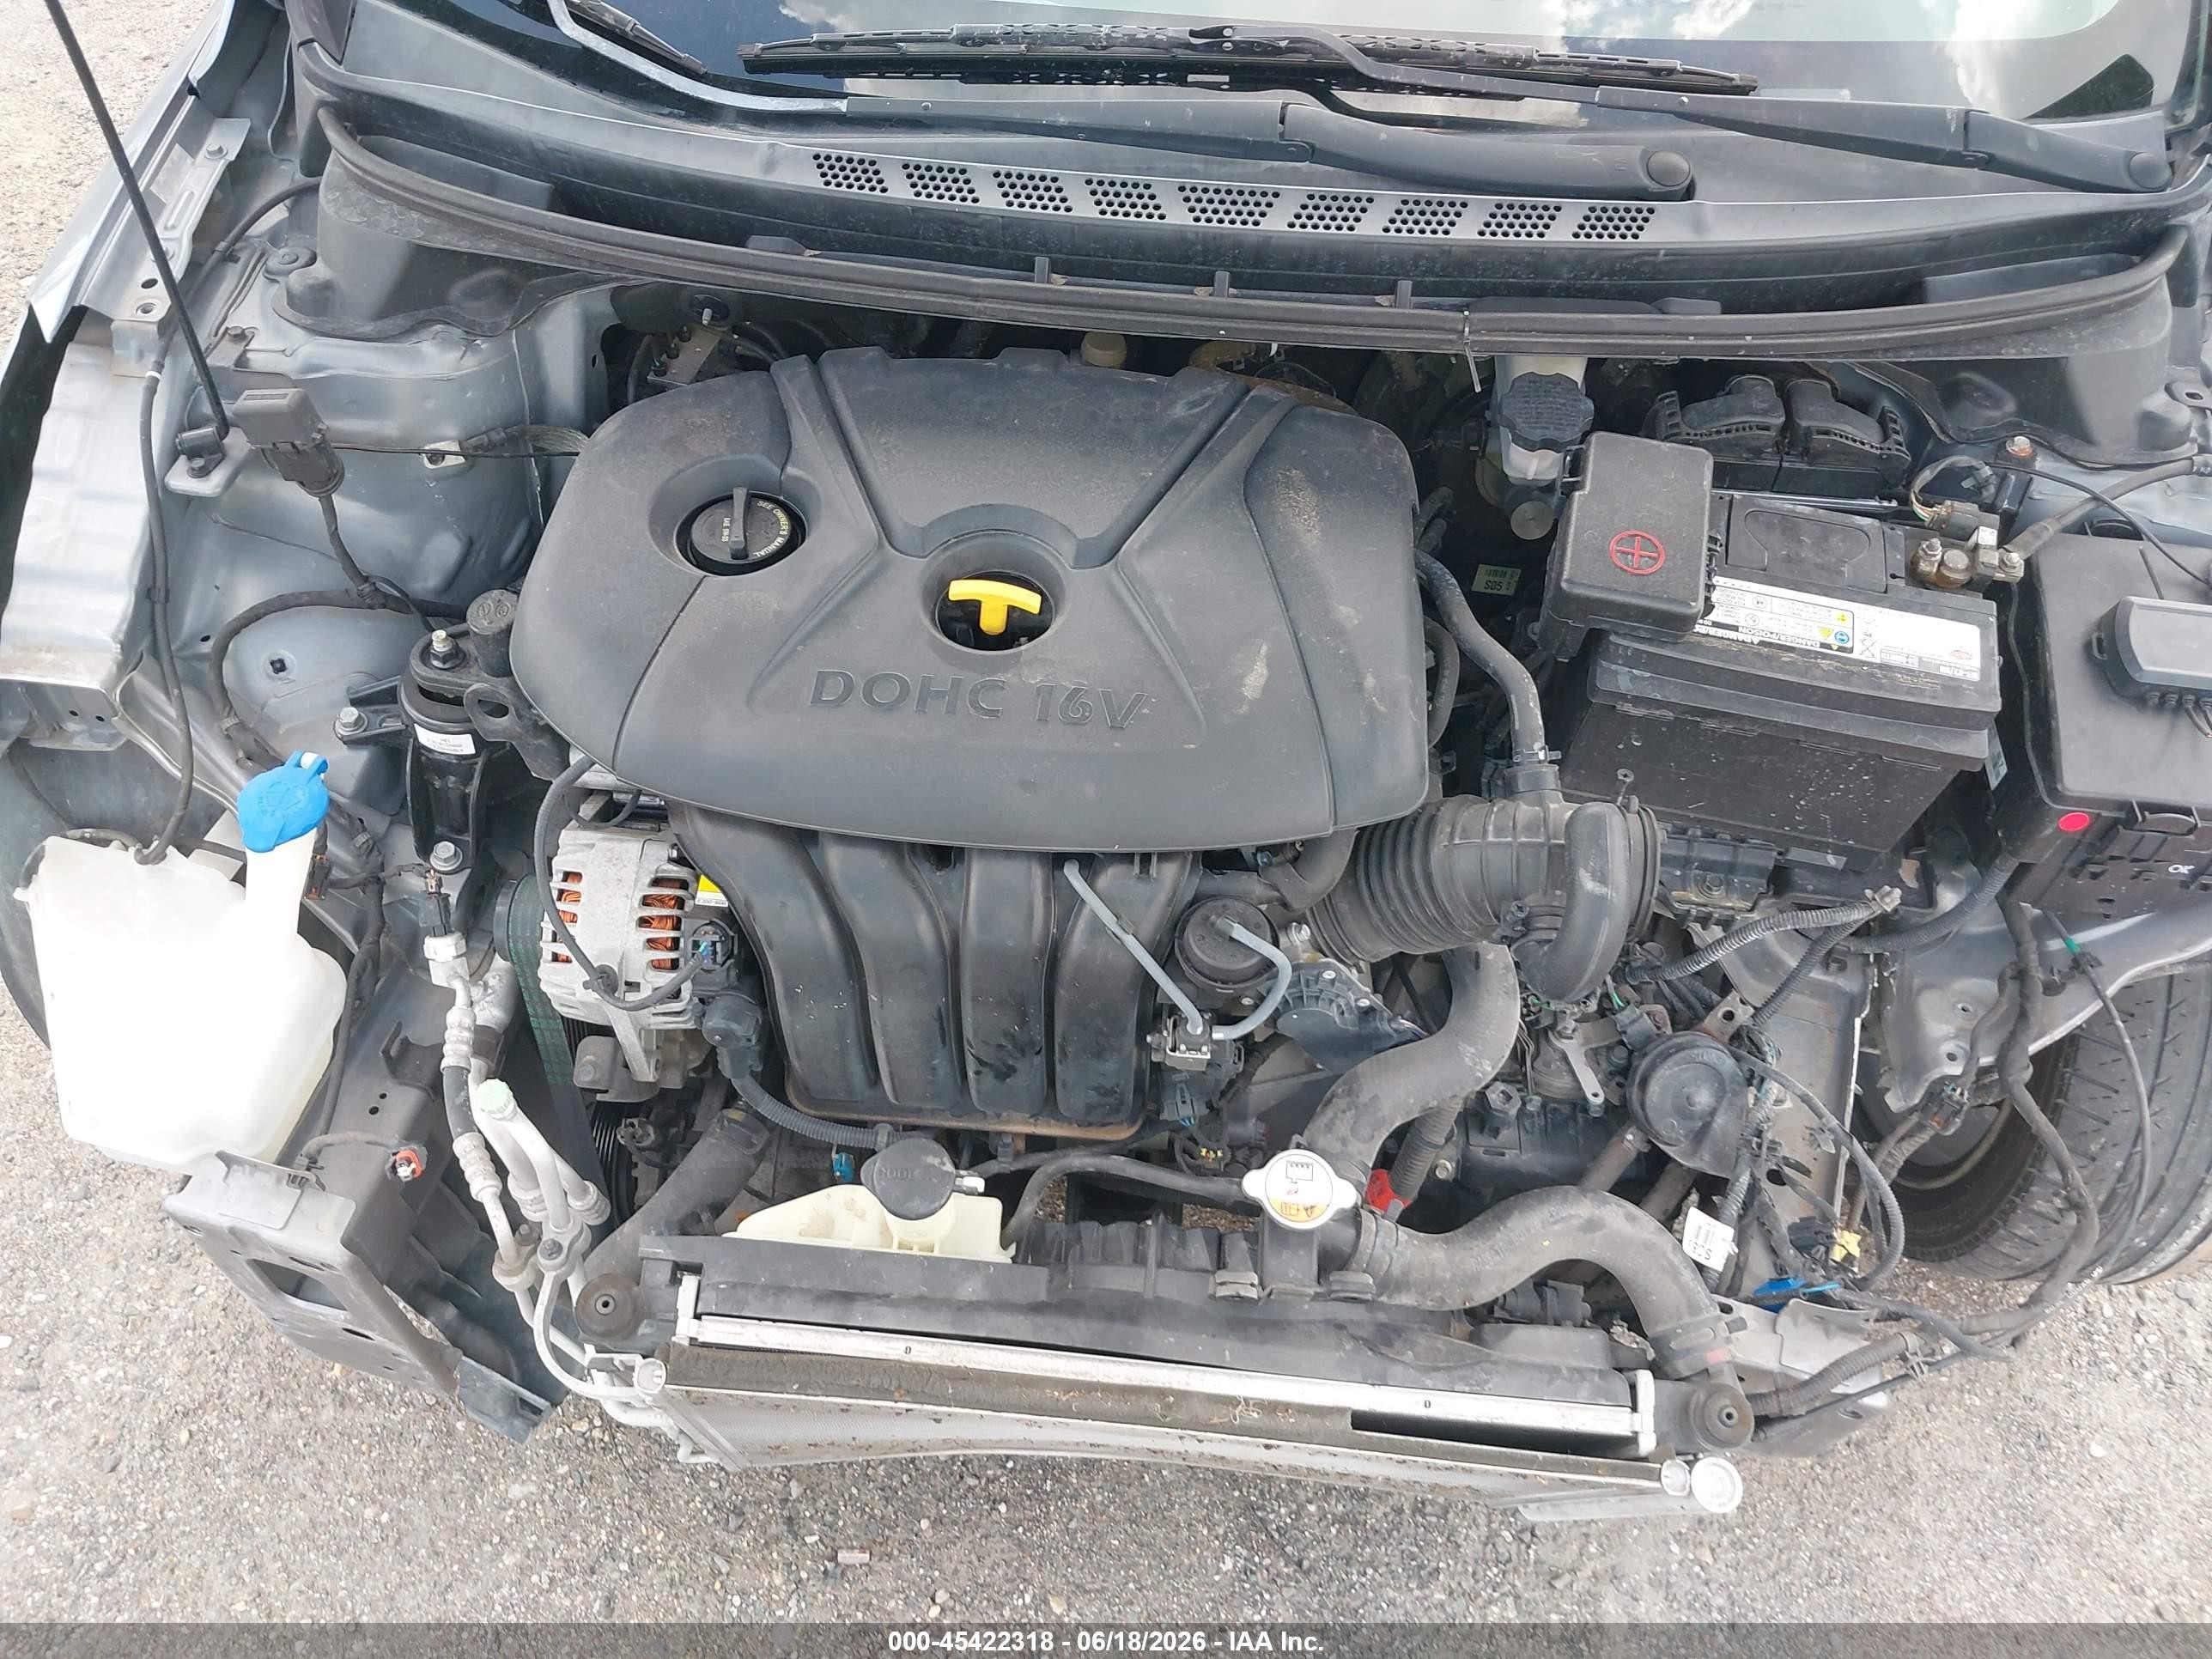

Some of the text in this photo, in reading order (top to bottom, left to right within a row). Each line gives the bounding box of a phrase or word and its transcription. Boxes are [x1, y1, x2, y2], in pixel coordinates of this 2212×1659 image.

[757, 501, 775, 511] SEE
[752, 537, 785, 558] MANUAL
[809, 669, 1149, 729] DOHC 16V
